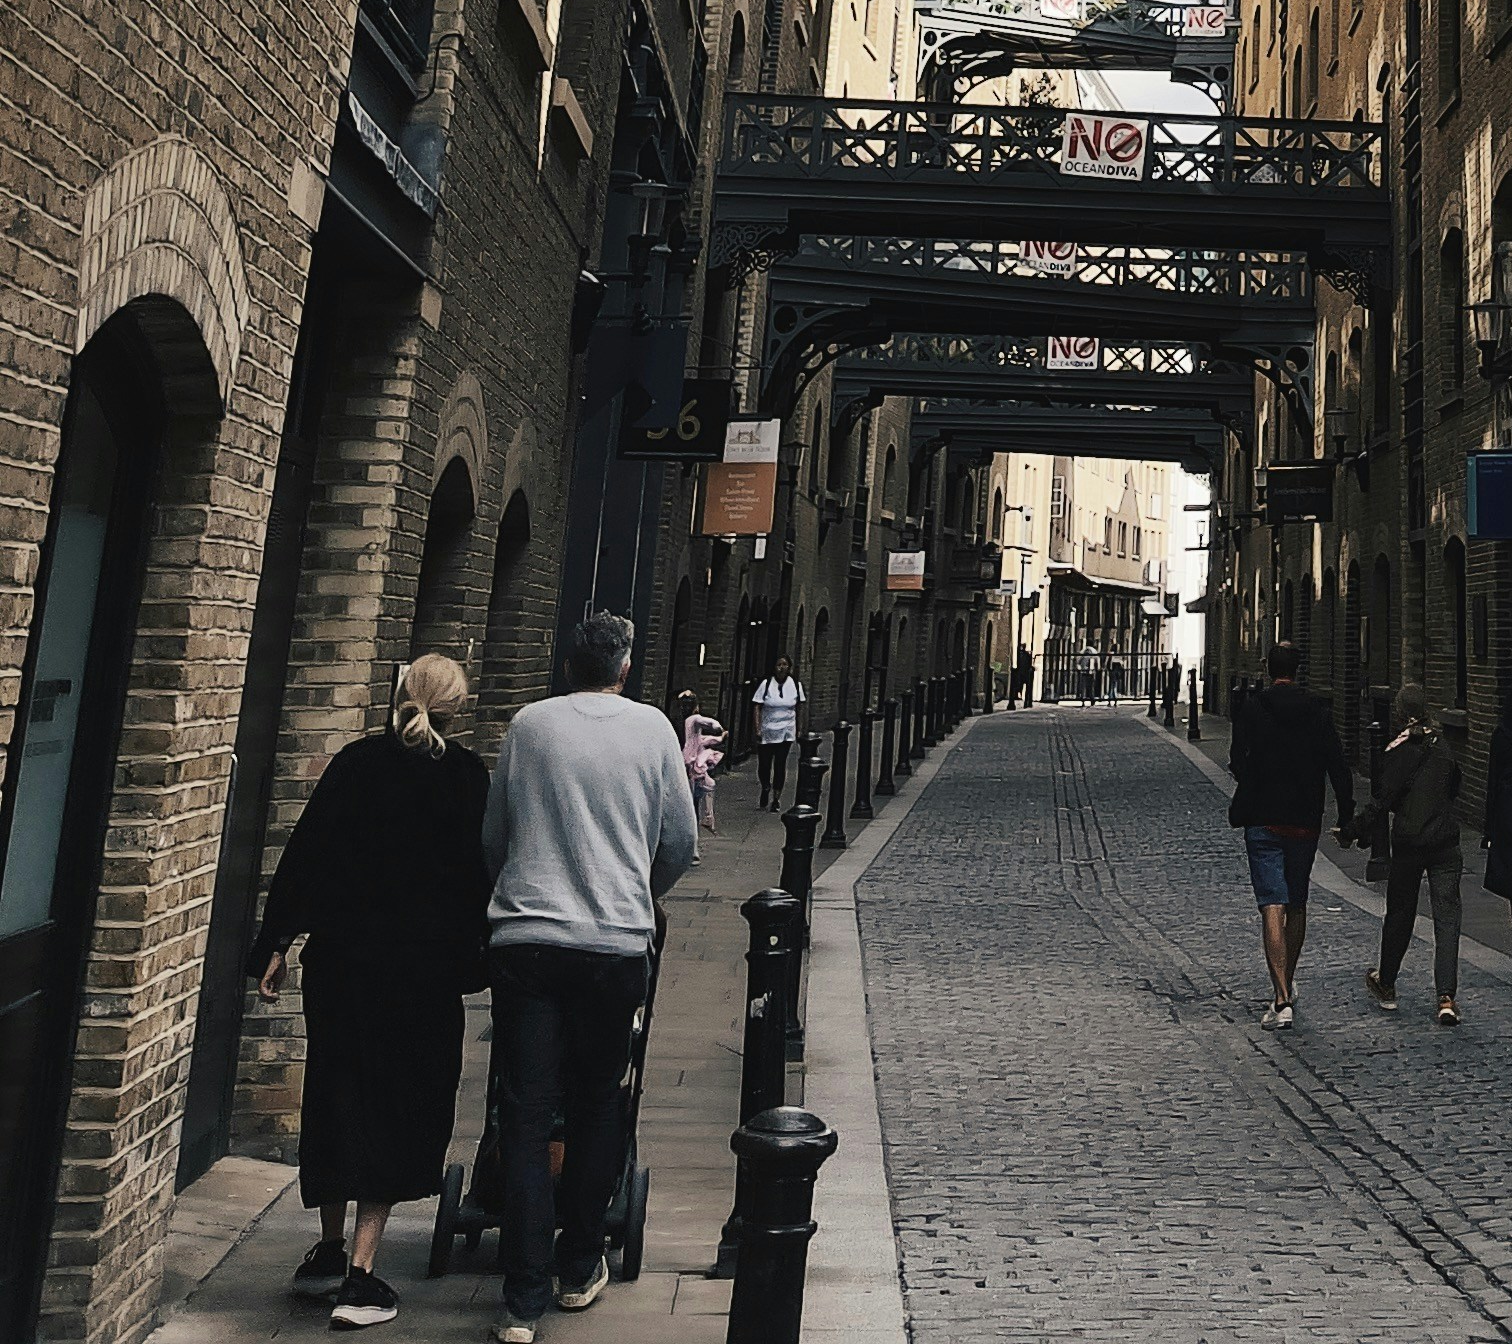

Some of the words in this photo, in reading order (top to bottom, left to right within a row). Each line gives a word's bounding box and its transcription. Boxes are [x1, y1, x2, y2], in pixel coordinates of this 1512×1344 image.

[1188, 8, 1223, 29] NO
[1067, 117, 1144, 163] NO
[1064, 160, 1138, 178] OCEANDIVA
[1051, 336, 1096, 359] NO
